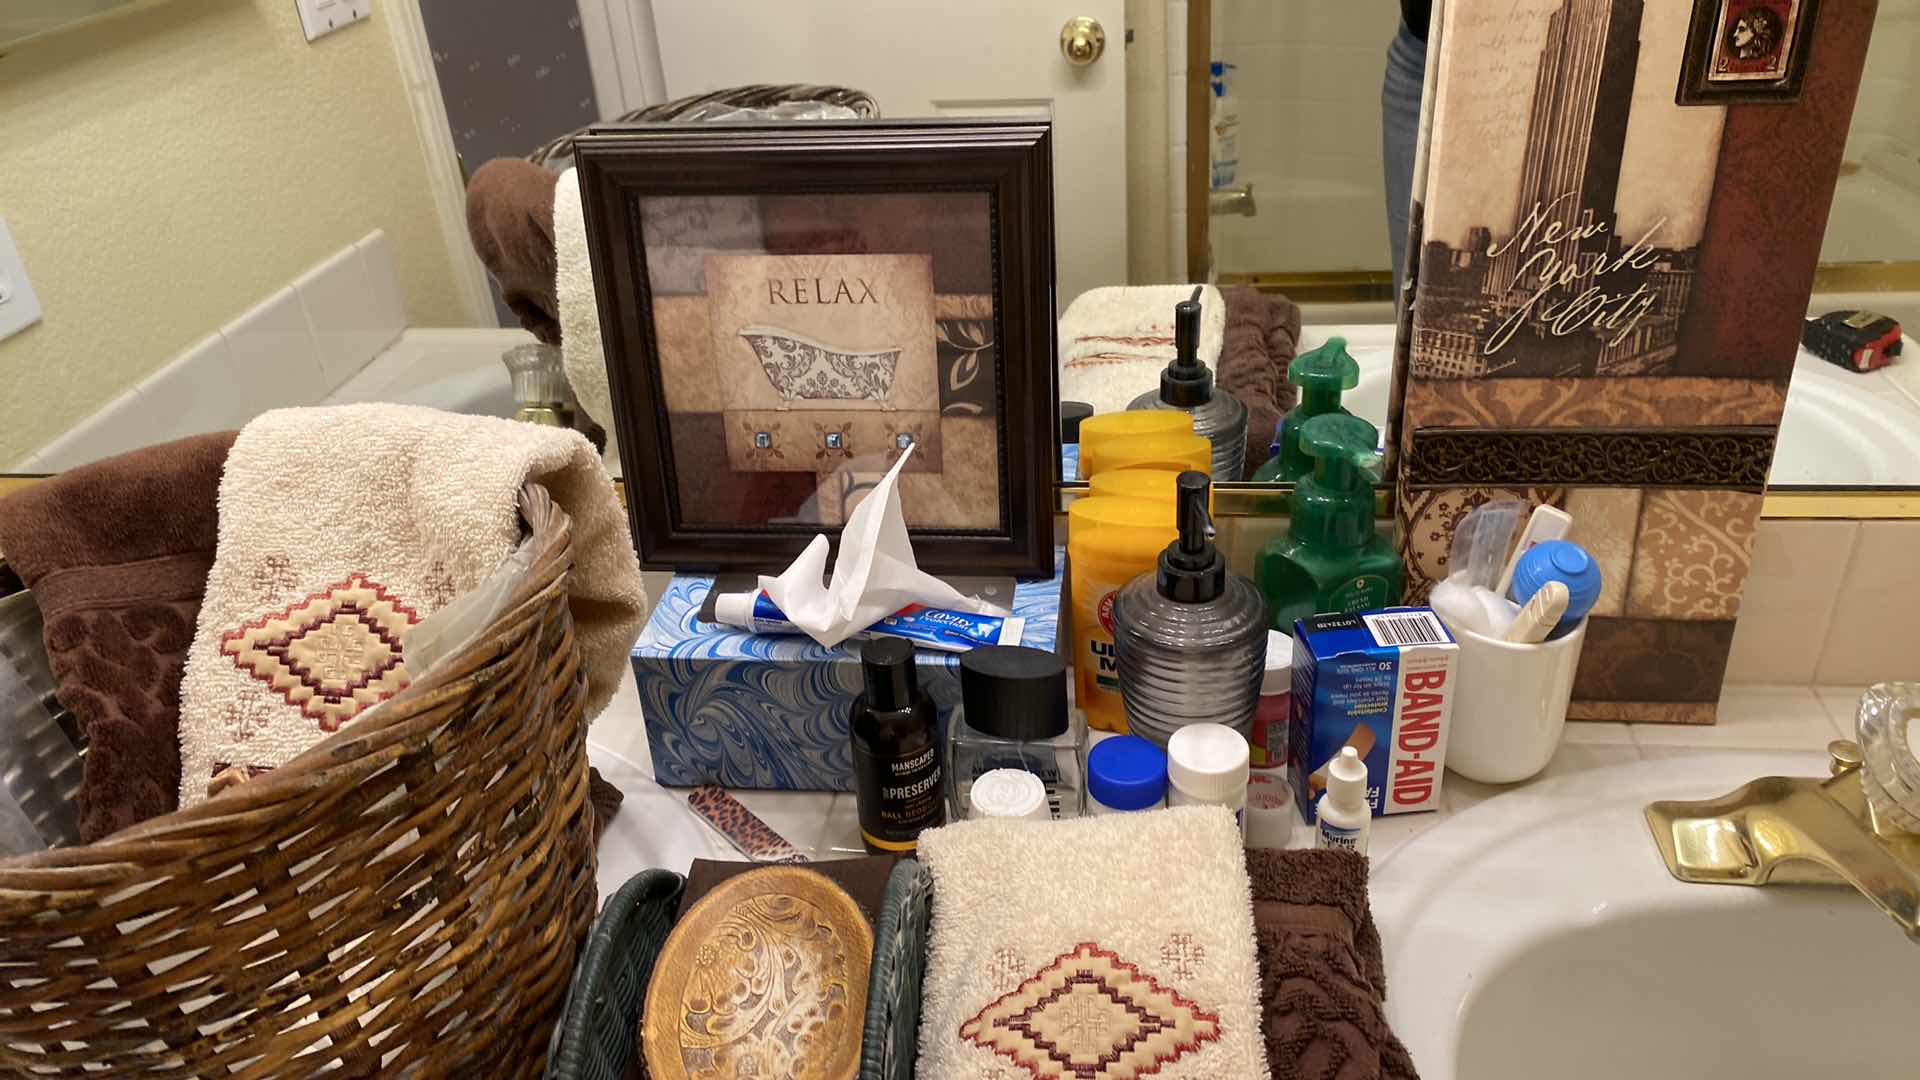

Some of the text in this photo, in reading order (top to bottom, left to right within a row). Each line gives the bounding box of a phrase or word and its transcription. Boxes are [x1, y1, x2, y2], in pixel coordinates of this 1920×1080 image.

[1486, 191, 1608, 257] New
[768, 277, 879, 304] RELAX
[1484, 216, 1667, 355] York
[1541, 284, 1656, 347] City
[1379, 661, 1393, 671] 30
[1392, 669, 1447, 805] BAND-AID
